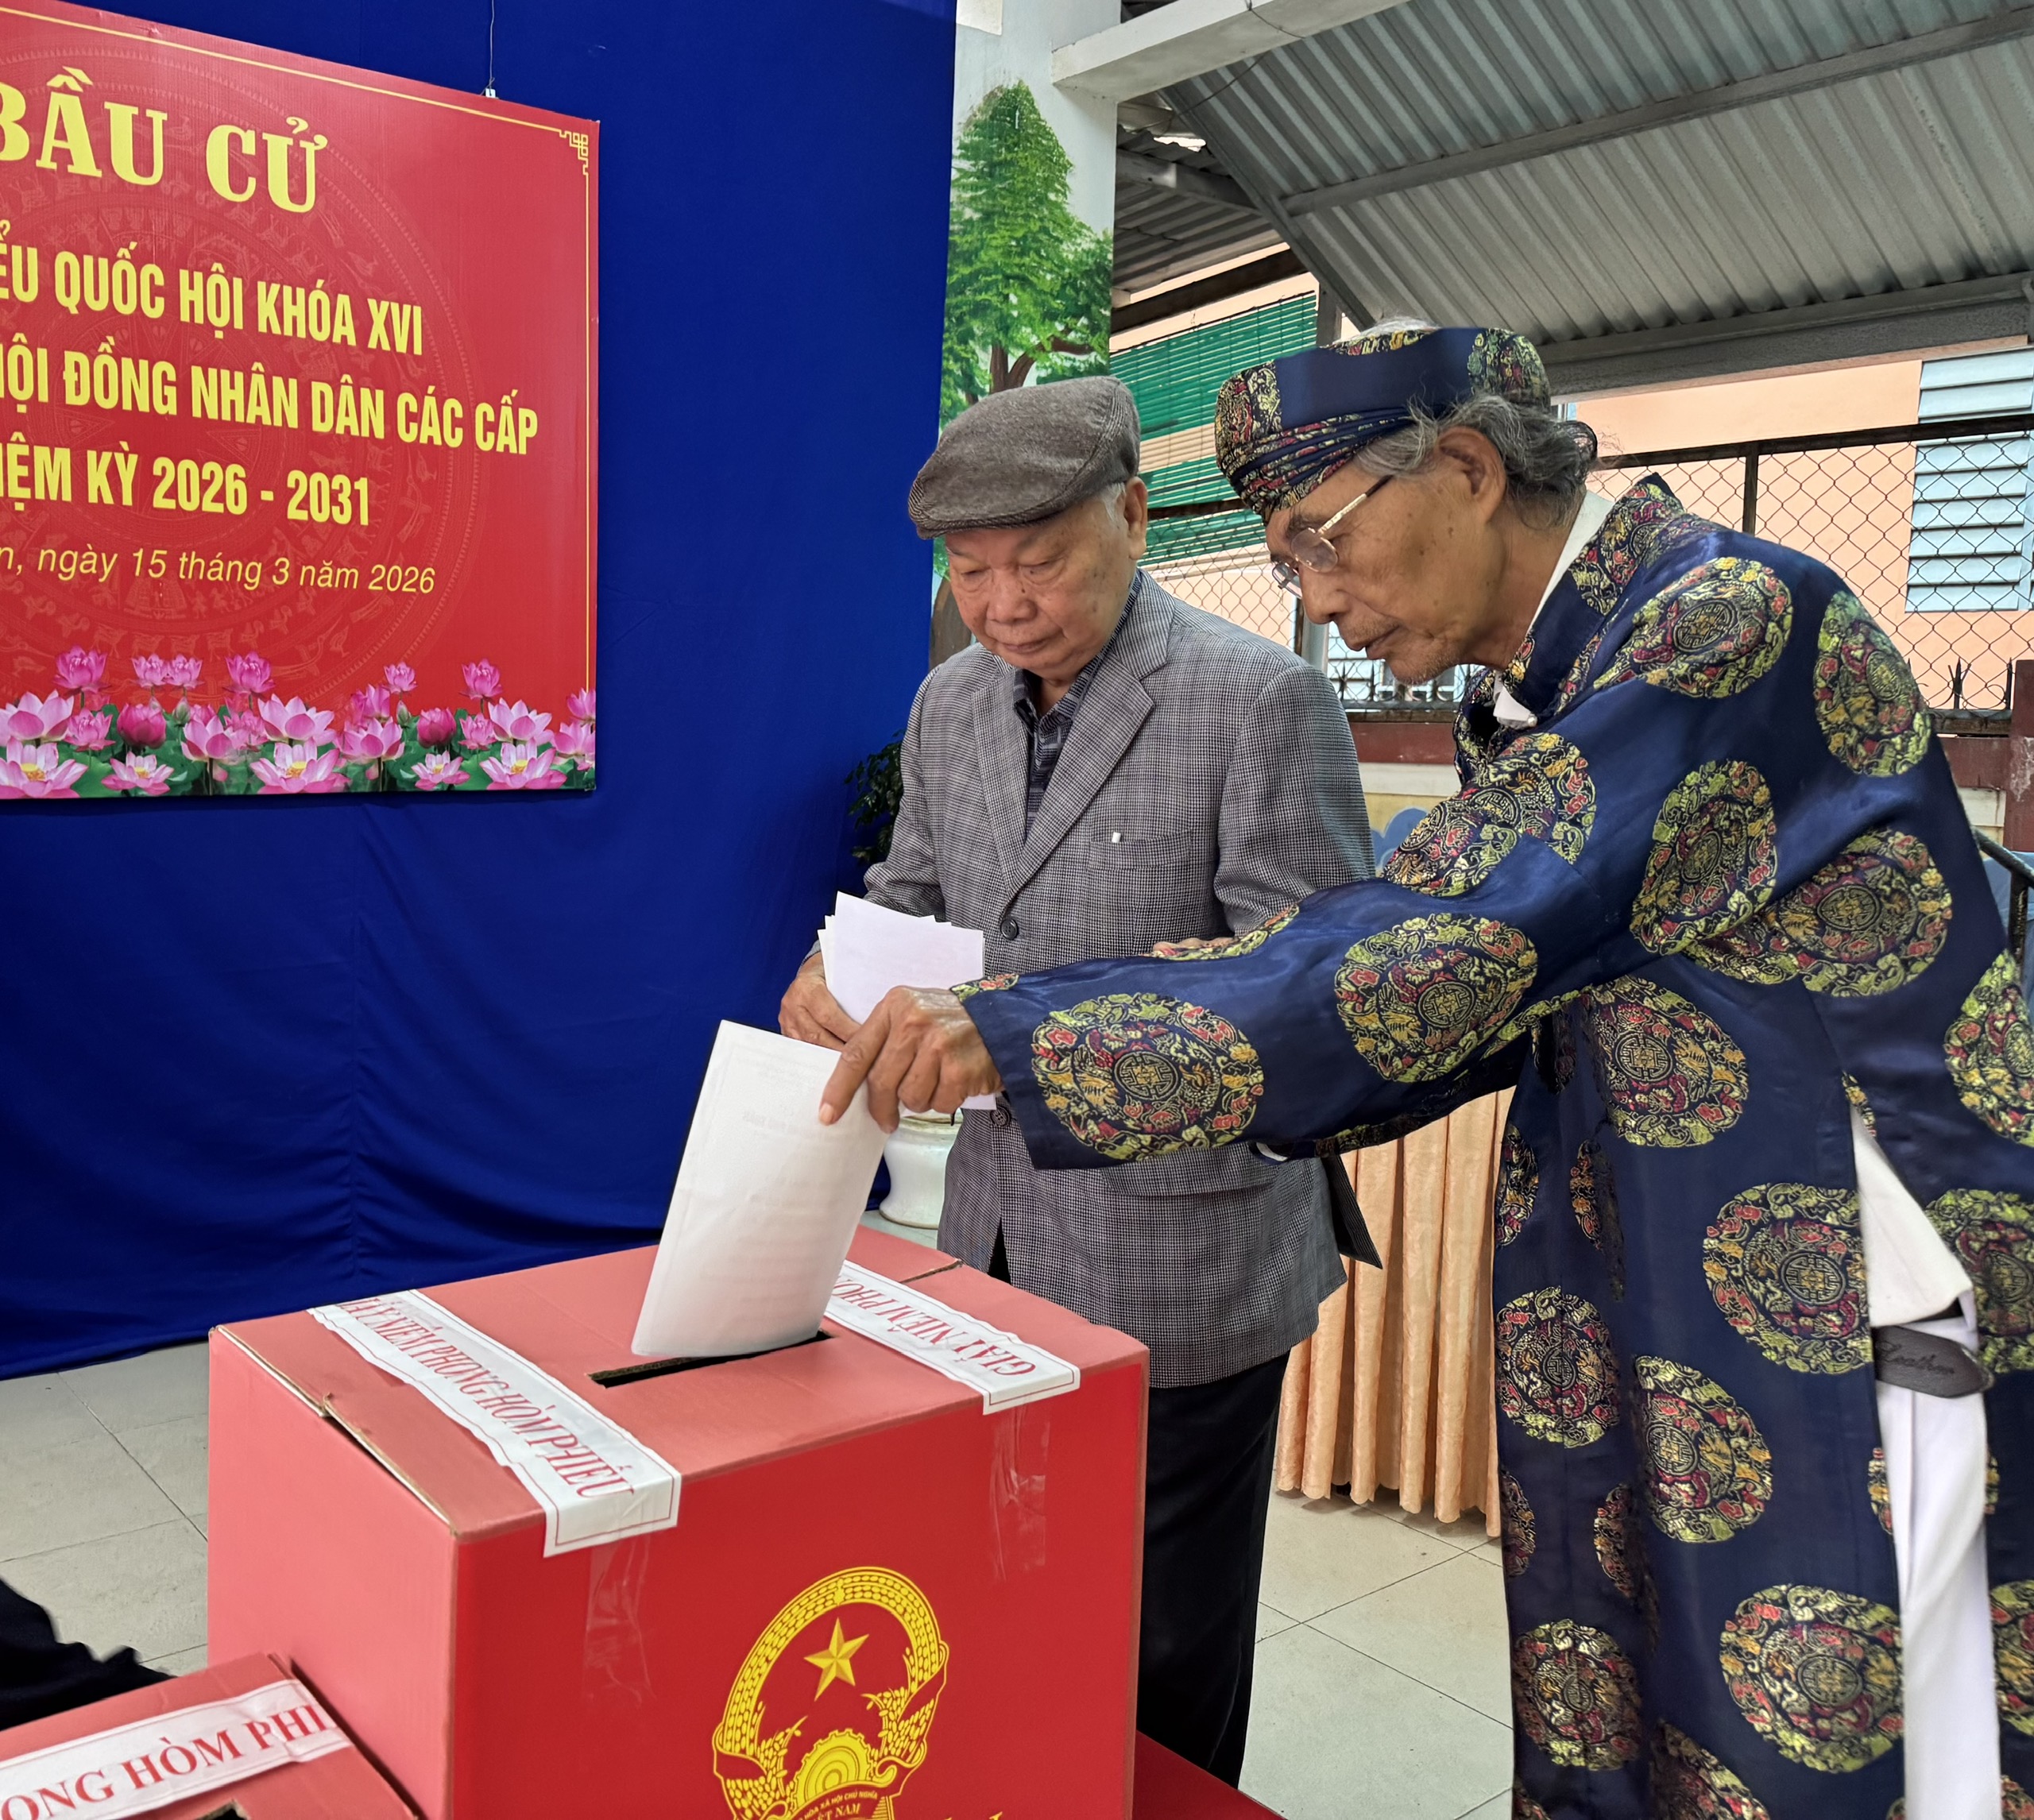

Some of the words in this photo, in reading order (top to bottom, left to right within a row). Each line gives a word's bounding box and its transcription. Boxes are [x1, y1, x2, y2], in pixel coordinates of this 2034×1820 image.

[0, 66, 168, 186] BẦU
[205, 116, 327, 213] CỬ
[54, 242, 164, 319] QUỐC
[179, 262, 243, 339] HỘI
[257, 279, 356, 346] KHÓA
[367, 297, 423, 355] XVI
[63, 336, 177, 415] ĐỒNG
[191, 361, 298, 429] NHÂN
[311, 373, 385, 439] DÂN
[396, 385, 463, 448] CÁC
[475, 388, 538, 454] CẤP
[87, 441, 138, 507] KỲ
[153, 456, 248, 516] 2026
[261, 490, 274, 501] -
[287, 469, 369, 526] 2031
[37, 543, 118, 582] ngày
[132, 548, 168, 578] 15
[179, 551, 261, 590] tháng
[272, 557, 290, 585] 3
[300, 560, 359, 590] năm
[368, 564, 436, 594] 2026
[830, 1278, 899, 1316] PHO
[409, 1345, 509, 1395] PHONG
[473, 1393, 556, 1435] HÒM
[524, 1424, 635, 1498] PHIẾU
[1, 1769, 114, 1820] ONG
[119, 1729, 243, 1790] HÒM
[242, 1705, 327, 1750] PHI
[834, 1803, 860, 1818] NAM
